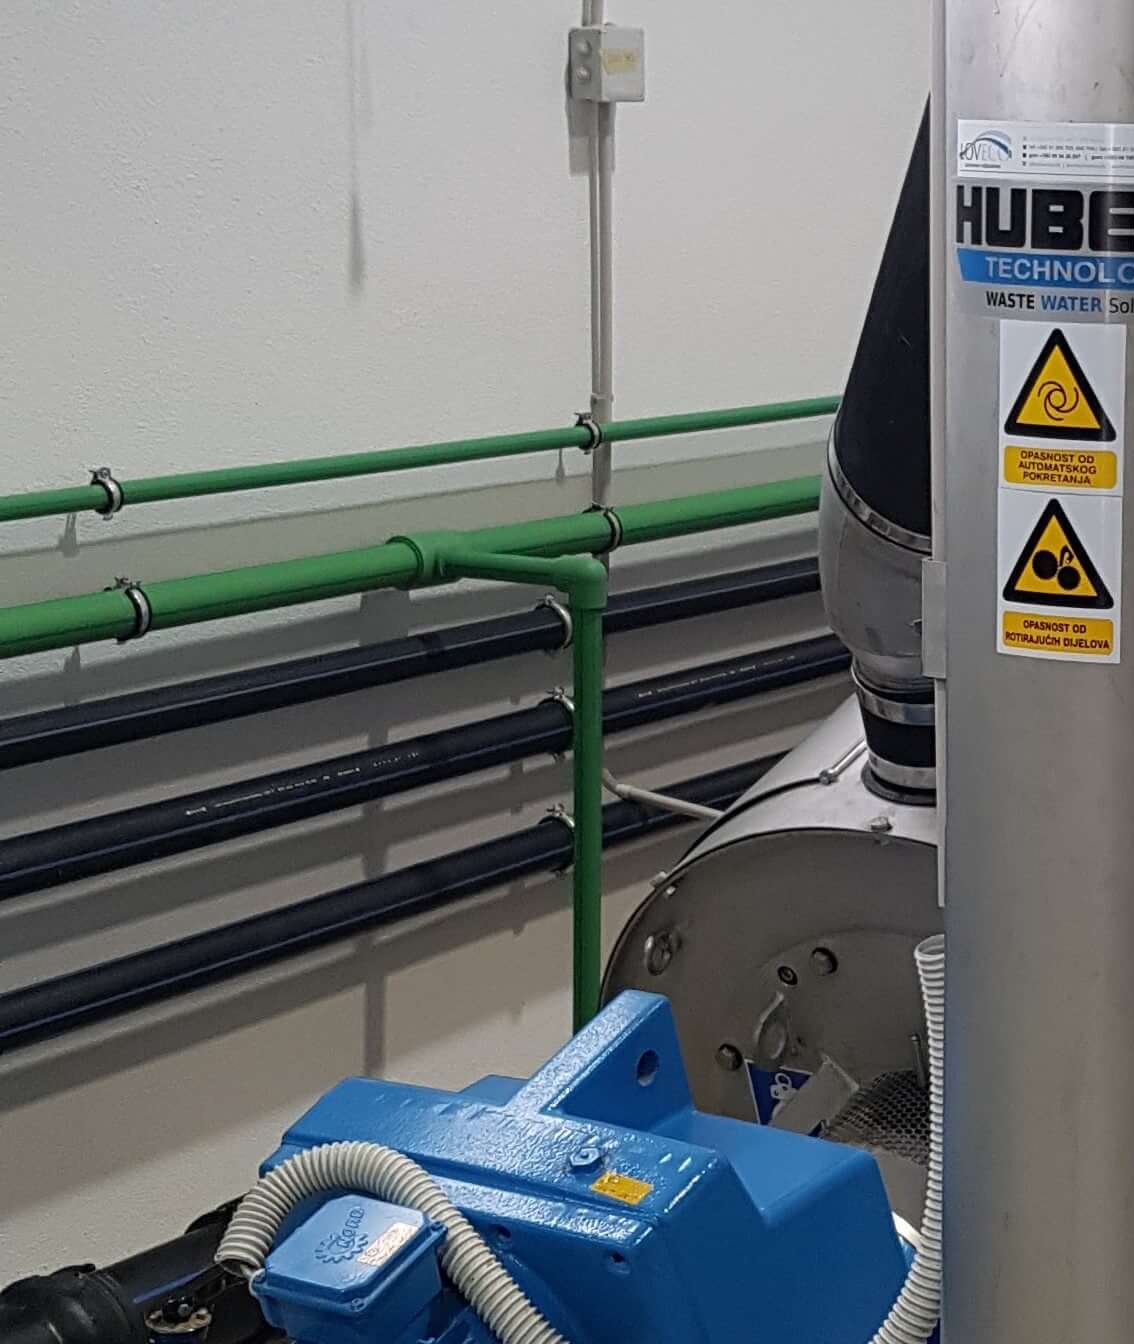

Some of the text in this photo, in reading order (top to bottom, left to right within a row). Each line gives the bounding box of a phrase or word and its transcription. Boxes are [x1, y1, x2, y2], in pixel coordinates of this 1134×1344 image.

[986, 291, 1035, 309] WASTE
[1040, 296, 1103, 312] WATER
[1020, 450, 1095, 464] OPASNOST OD
[1018, 461, 1097, 475] AUTOMATSKOG
[1023, 471, 1091, 484] POKRETANJA
[1023, 620, 1087, 634] OPASNOST OD
[1063, 637, 1110, 649] DIJELOVA
